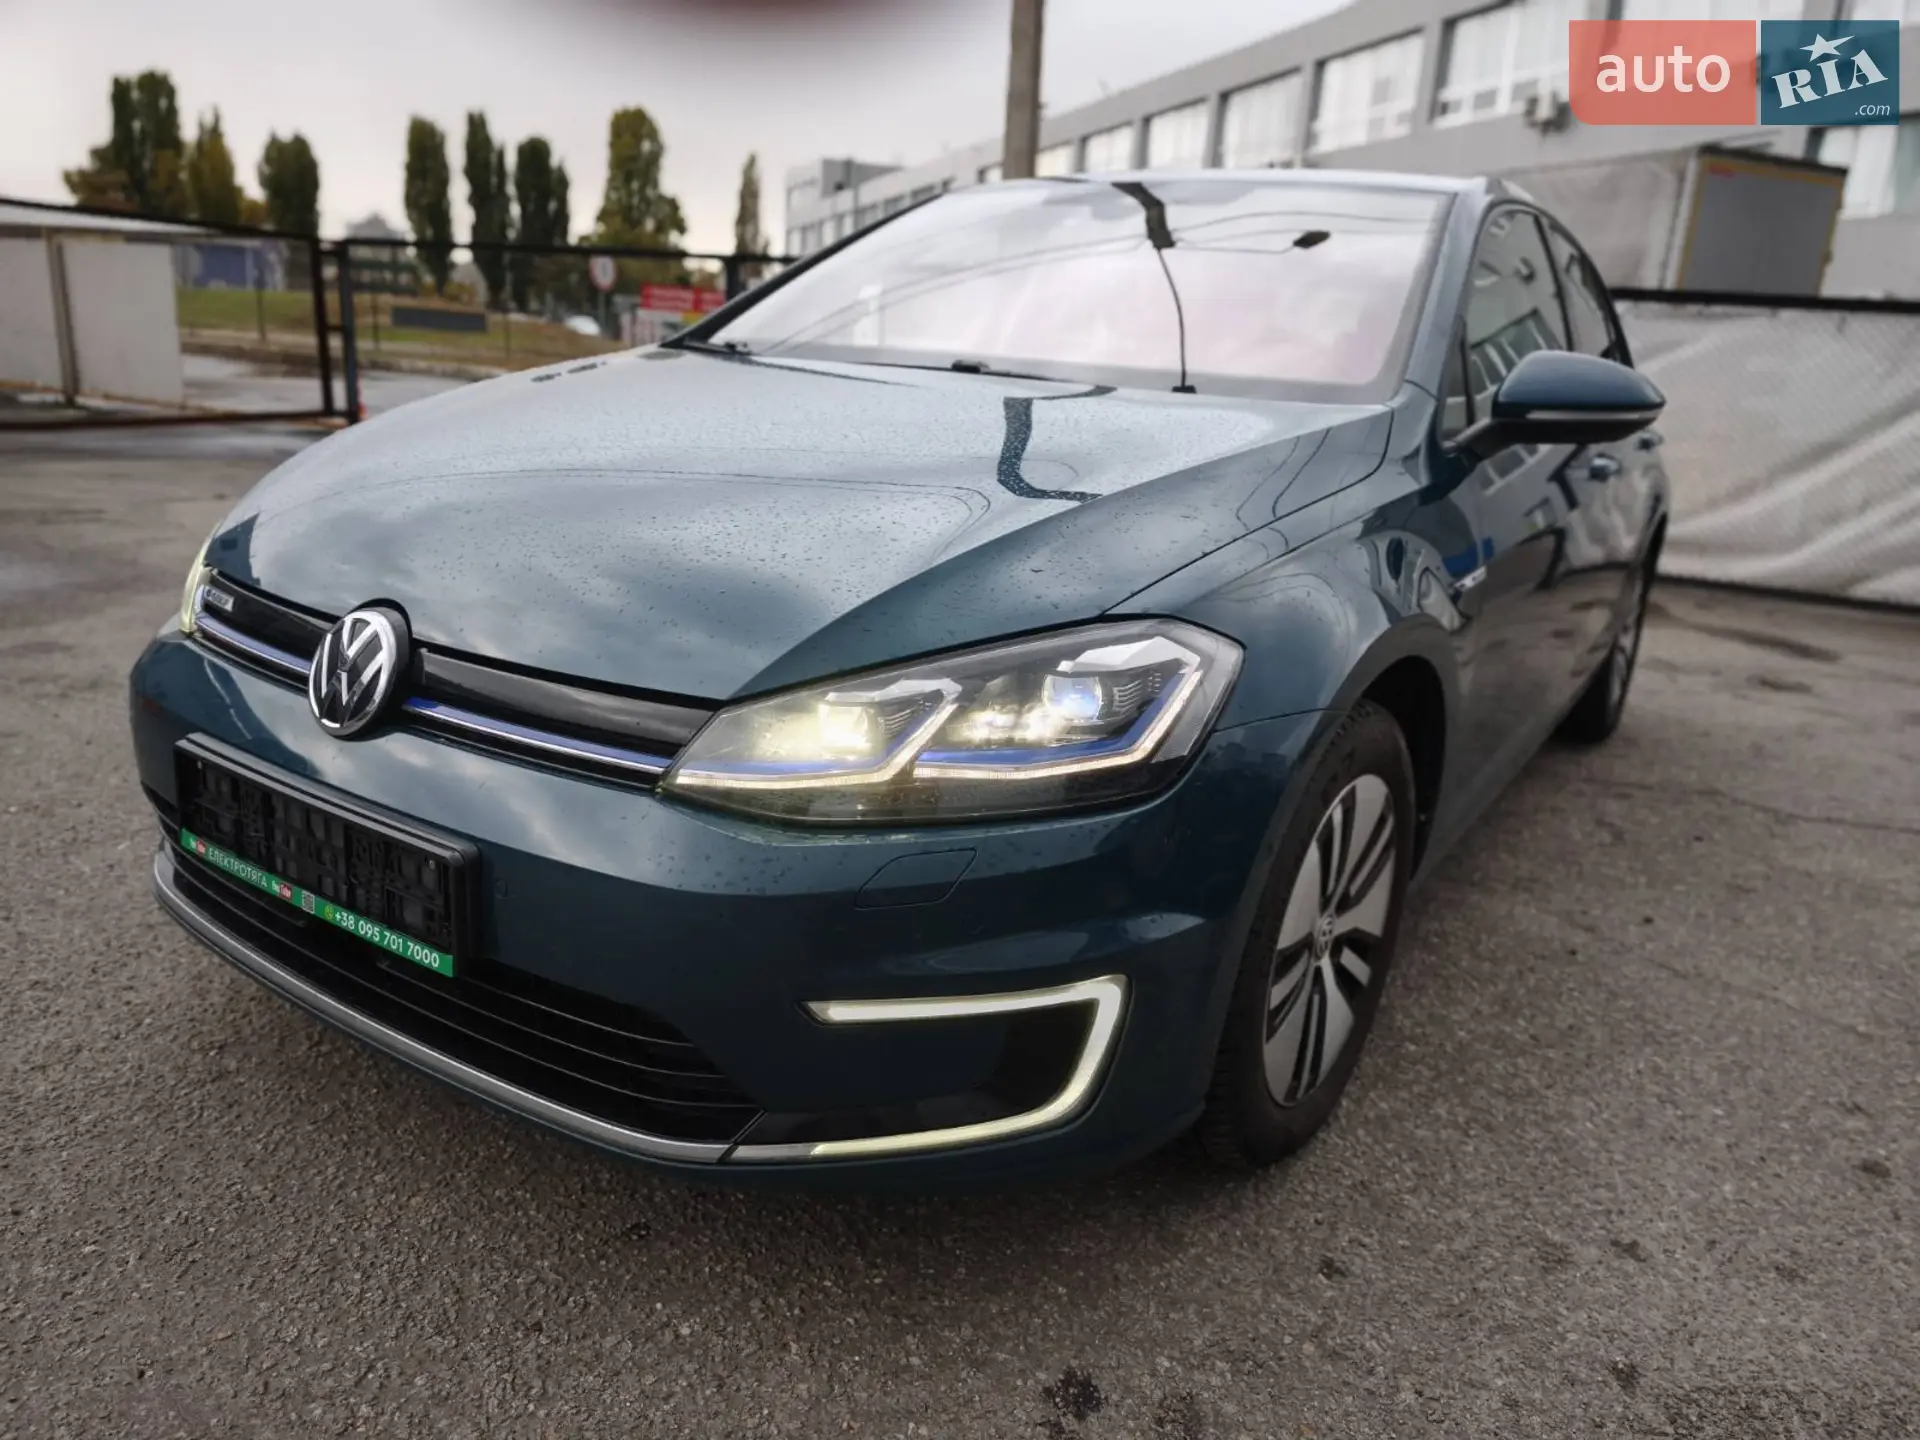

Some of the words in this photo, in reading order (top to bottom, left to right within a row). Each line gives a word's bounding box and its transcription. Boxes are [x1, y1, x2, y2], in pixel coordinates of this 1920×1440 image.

[335, 911, 355, 930] +38
[358, 920, 380, 942] 095
[383, 931, 403, 953] 701
[407, 941, 440, 968] 7000
